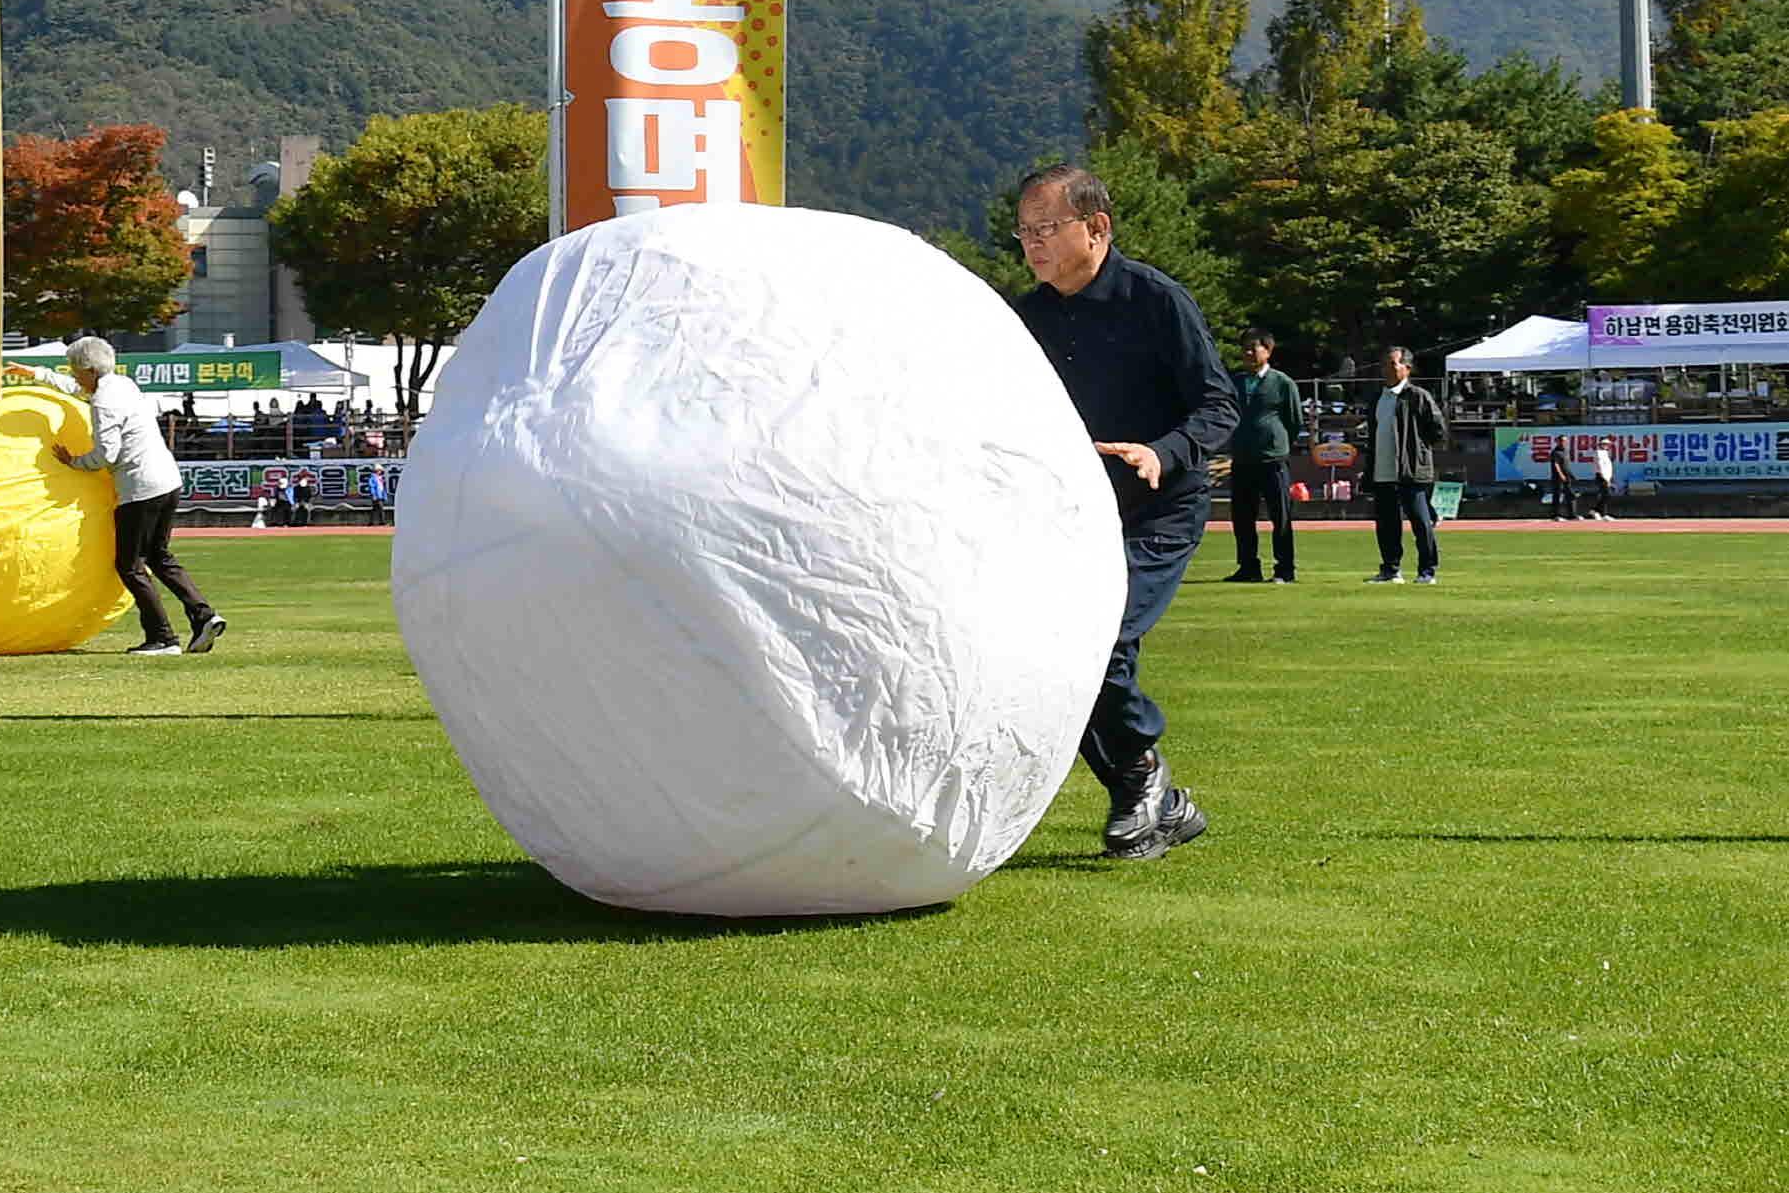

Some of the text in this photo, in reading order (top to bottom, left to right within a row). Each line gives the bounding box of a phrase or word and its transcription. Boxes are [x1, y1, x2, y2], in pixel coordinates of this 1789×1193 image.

[1605, 315, 1661, 337] 하남면
[134, 362, 191, 385] 상서면
[196, 361, 254, 384] 본부석
[1663, 432, 1709, 463] 뛰면
[1713, 431, 1771, 462] 하남!
